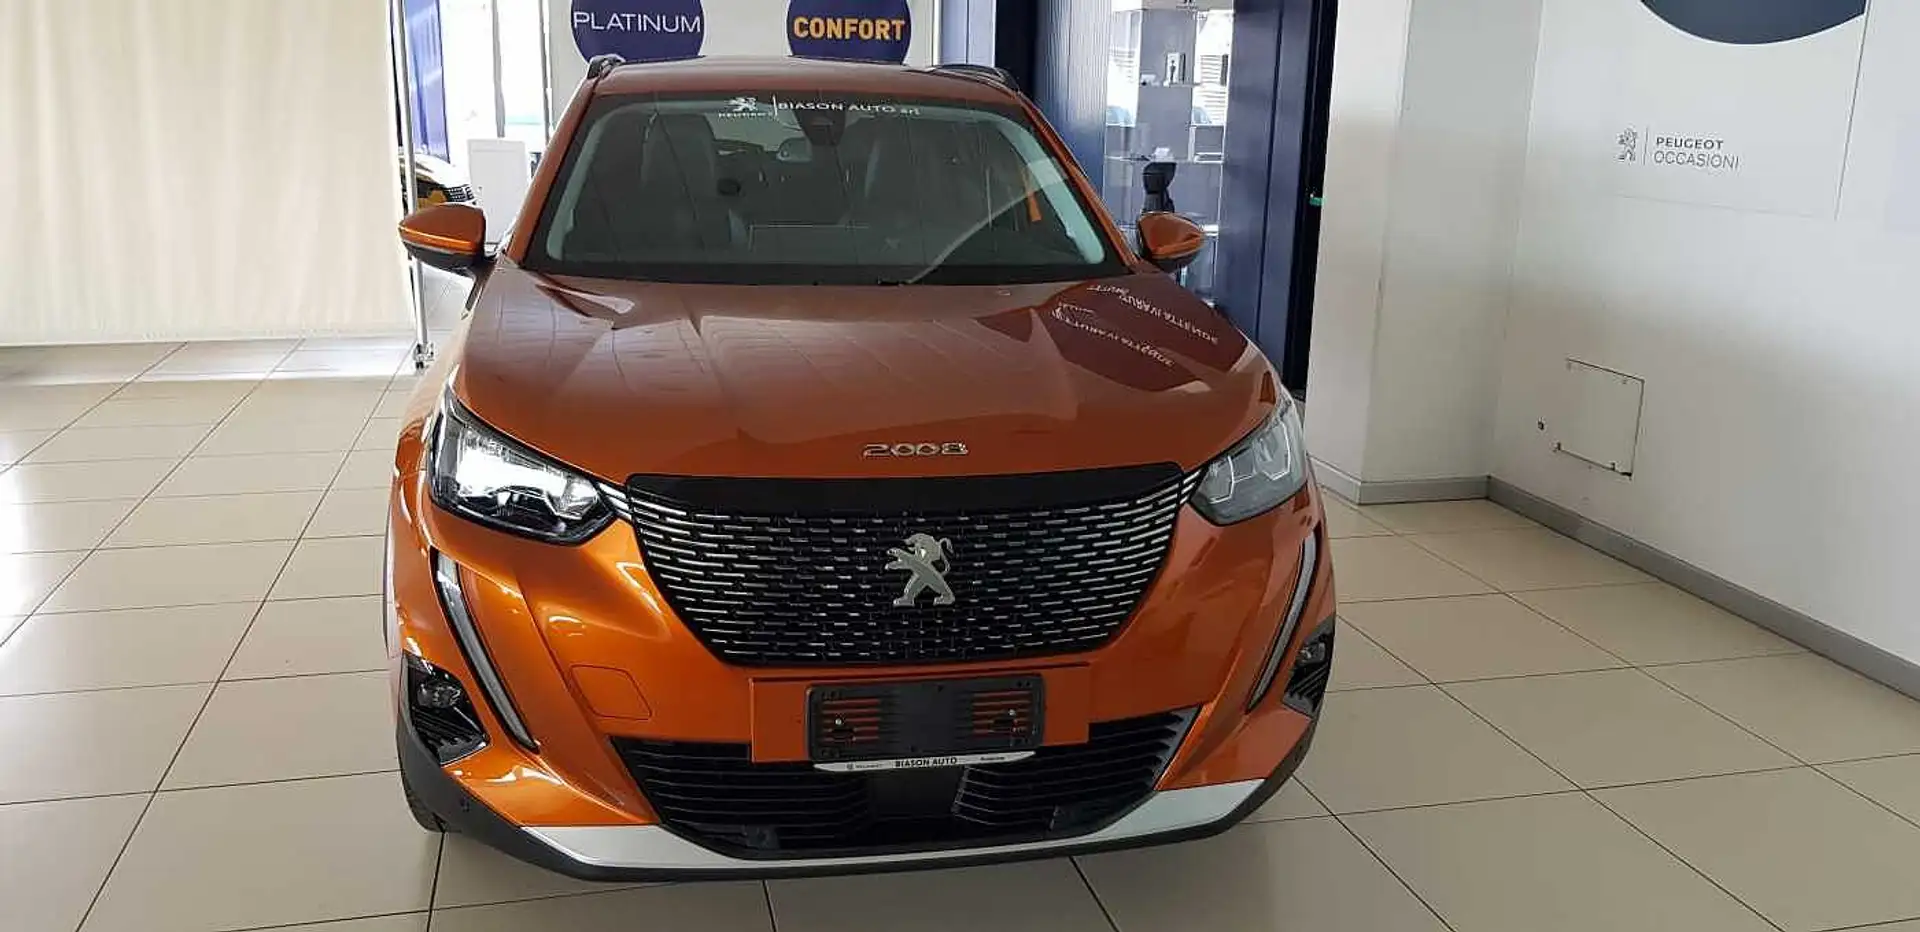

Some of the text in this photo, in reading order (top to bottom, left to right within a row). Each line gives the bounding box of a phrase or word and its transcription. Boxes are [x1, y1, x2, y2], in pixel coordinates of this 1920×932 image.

[573, 11, 701, 33] PLATINUM
[793, 16, 905, 41] CONFORT
[778, 101, 844, 111] BIASON
[848, 104, 896, 113] AUTO
[1656, 137, 1724, 150] PEUGEOT
[1654, 151, 1740, 169] OCCASIONI
[863, 442, 969, 457] 2008
[895, 756, 958, 768] BIASON AUTO
